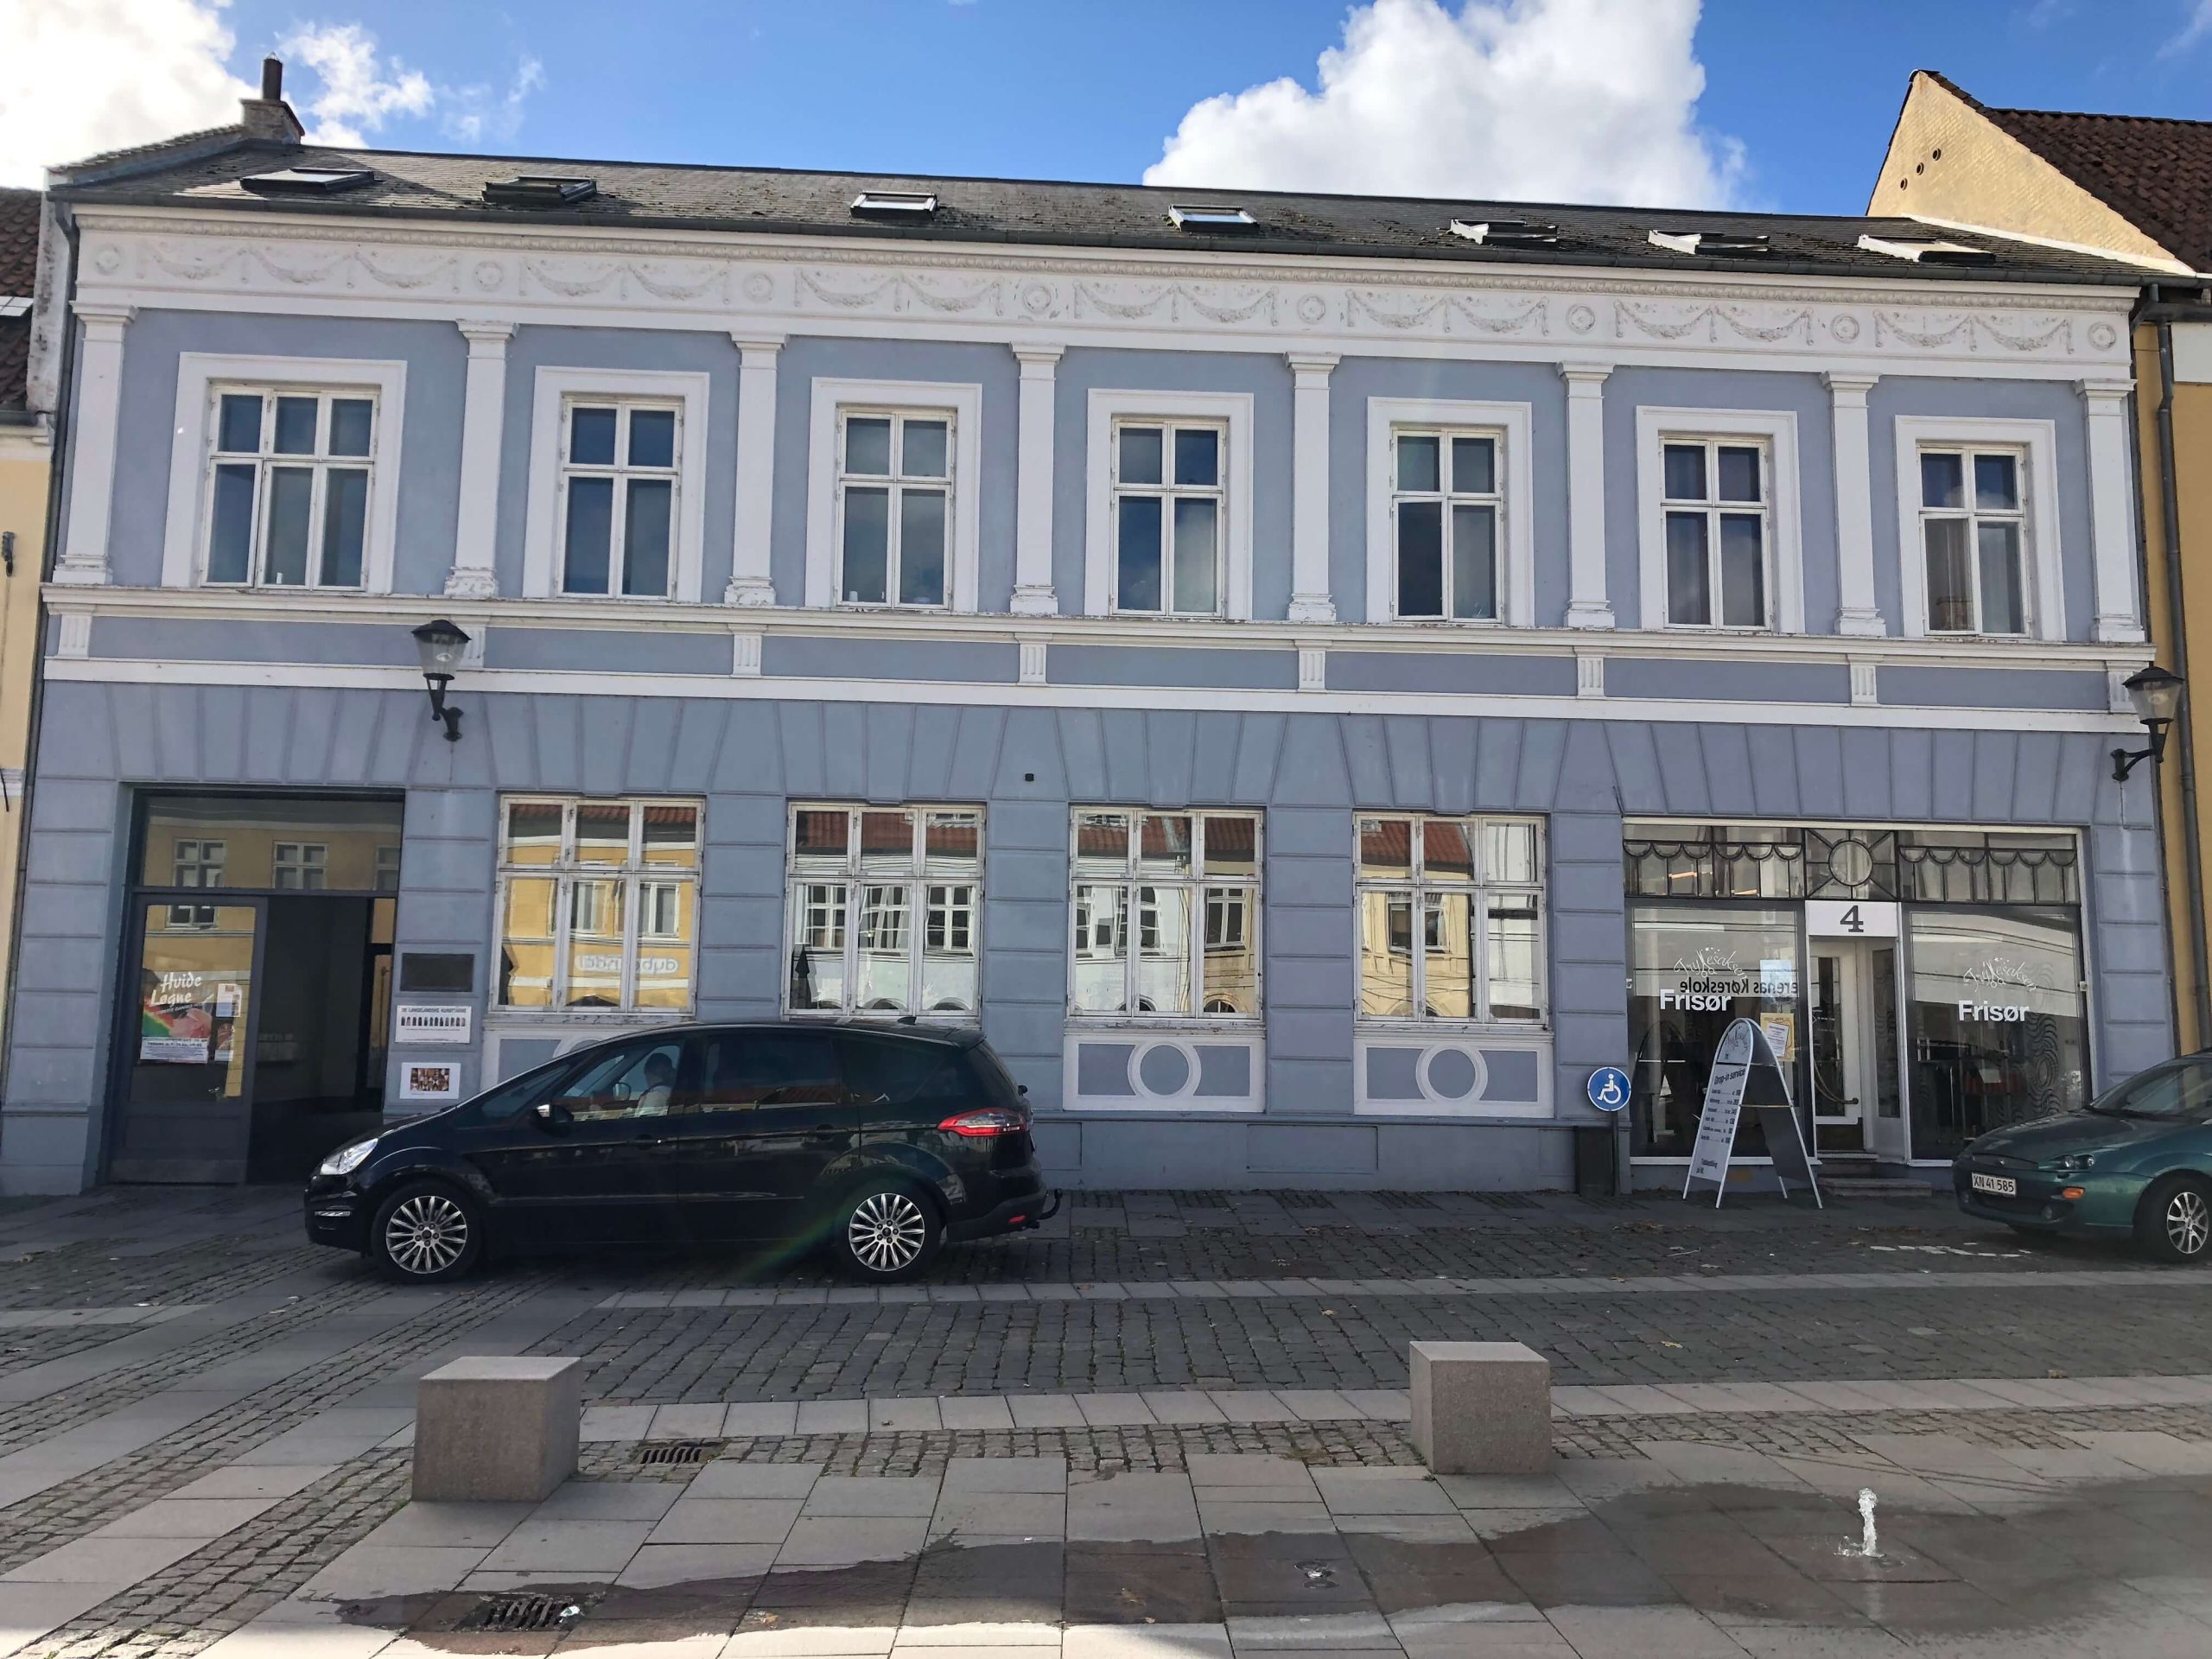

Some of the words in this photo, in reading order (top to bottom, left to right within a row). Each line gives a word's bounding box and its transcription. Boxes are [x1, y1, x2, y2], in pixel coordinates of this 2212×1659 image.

[1840, 905, 1864, 932] 4
[160, 971, 201, 993] Hvide
[149, 989, 192, 1007] Løgne
[1660, 988, 1732, 1012] Frisør
[1958, 1000, 2030, 1022] Frisør
[1714, 1073, 1730, 1085] Drop-in
[1974, 1175, 1985, 1188] XN
[1986, 1178, 1994, 1190] 41
[1997, 1179, 2014, 1192] 585
